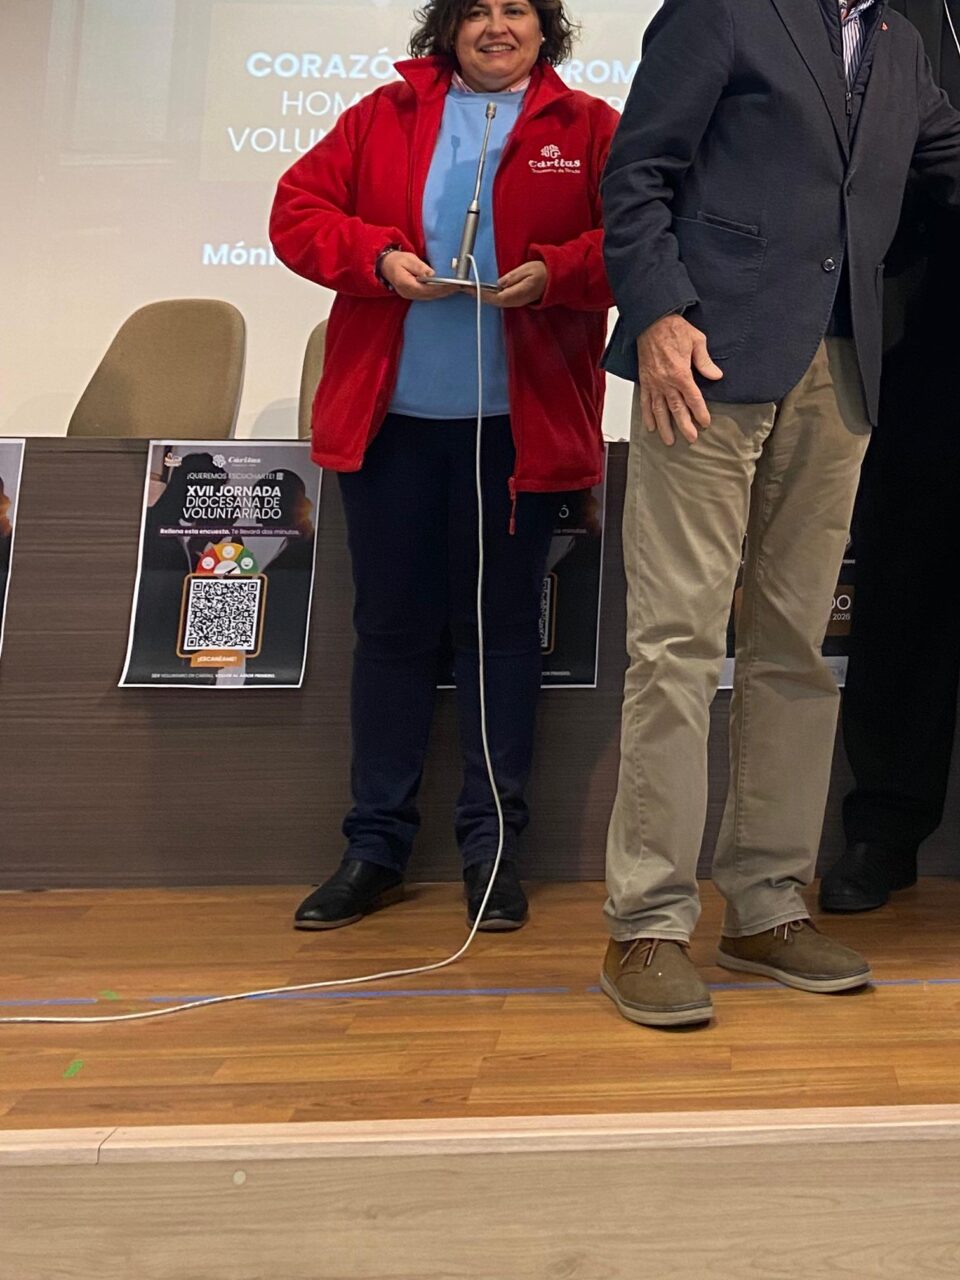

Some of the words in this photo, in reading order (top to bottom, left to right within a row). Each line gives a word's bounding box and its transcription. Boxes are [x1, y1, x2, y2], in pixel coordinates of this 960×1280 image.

[186, 485, 213, 496] XVII
[216, 485, 281, 497] JORNADA
[186, 497, 261, 507] DIOCESANA
[264, 497, 280, 507] DE
[183, 507, 282, 519] VOLUNTARIADO
